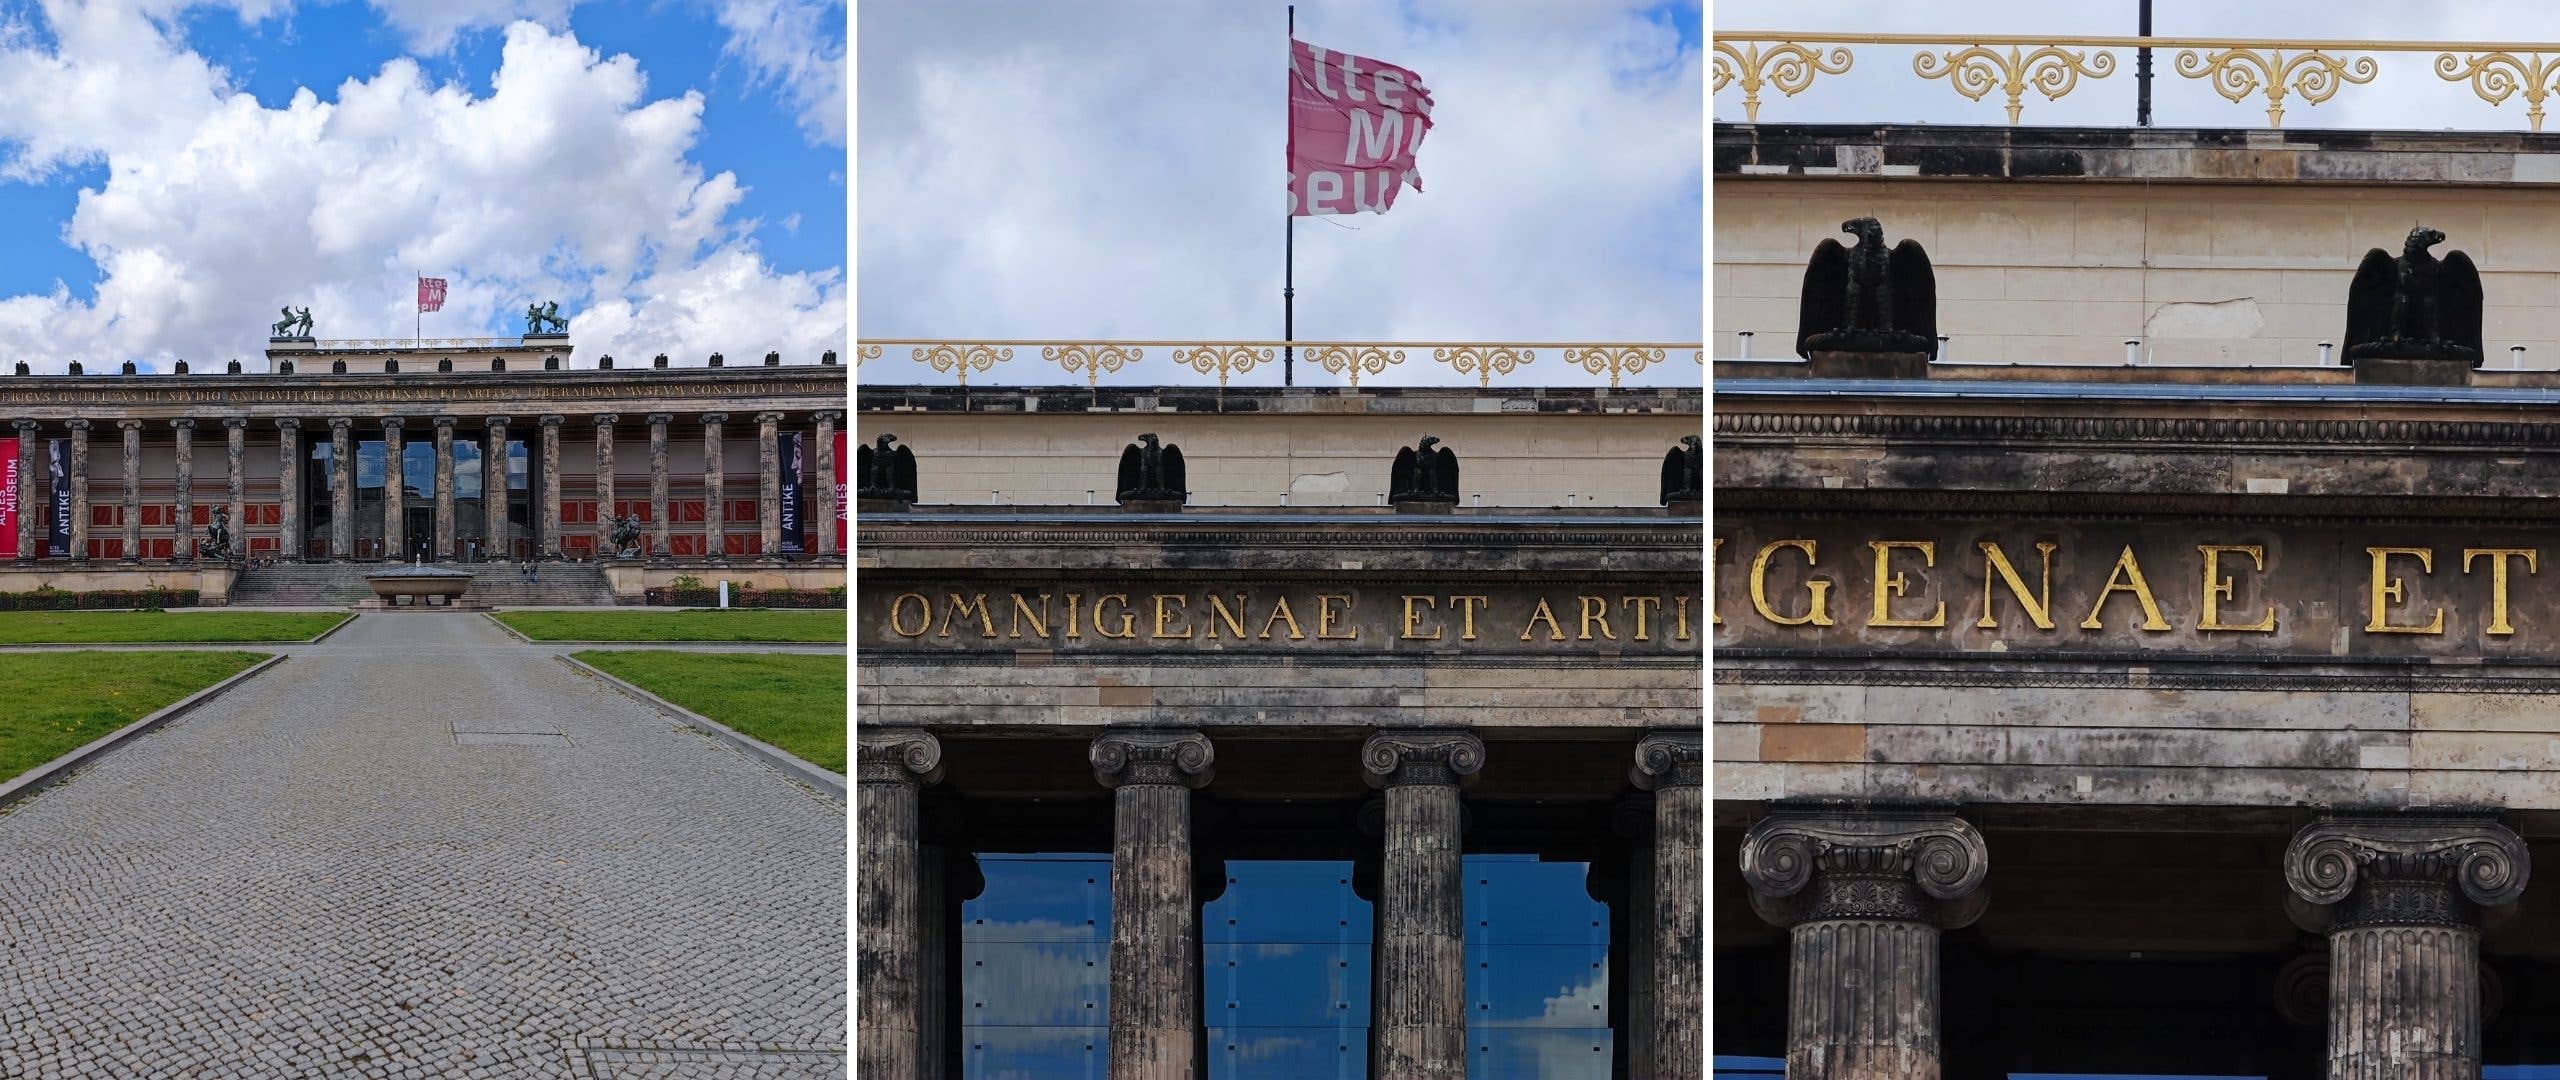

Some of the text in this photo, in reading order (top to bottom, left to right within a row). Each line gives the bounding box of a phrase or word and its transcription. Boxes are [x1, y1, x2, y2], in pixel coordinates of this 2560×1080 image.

[145, 392, 160, 402] III
[168, 391, 221, 401] STVDIO
[229, 390, 334, 401] ANTIQVITATIS
[341, 389, 432, 400] OMNIGENAE
[440, 389, 457, 399] ET
[464, 388, 518, 399] ARTIVM
[528, 387, 616, 398] LIBERALIVM
[624, 385, 685, 397] MVSEVM
[692, 383, 785, 395] CONSTITVIT
[6, 458, 18, 512] MUSEUM
[782, 483, 793, 531] ANTIKE
[835, 483, 847, 521] ALTES
[58, 490, 70, 535] ANTIKE
[2365, 546, 2537, 635] ET
[890, 592, 1357, 640] OMNIGENAE
[1400, 594, 1489, 641] ET
